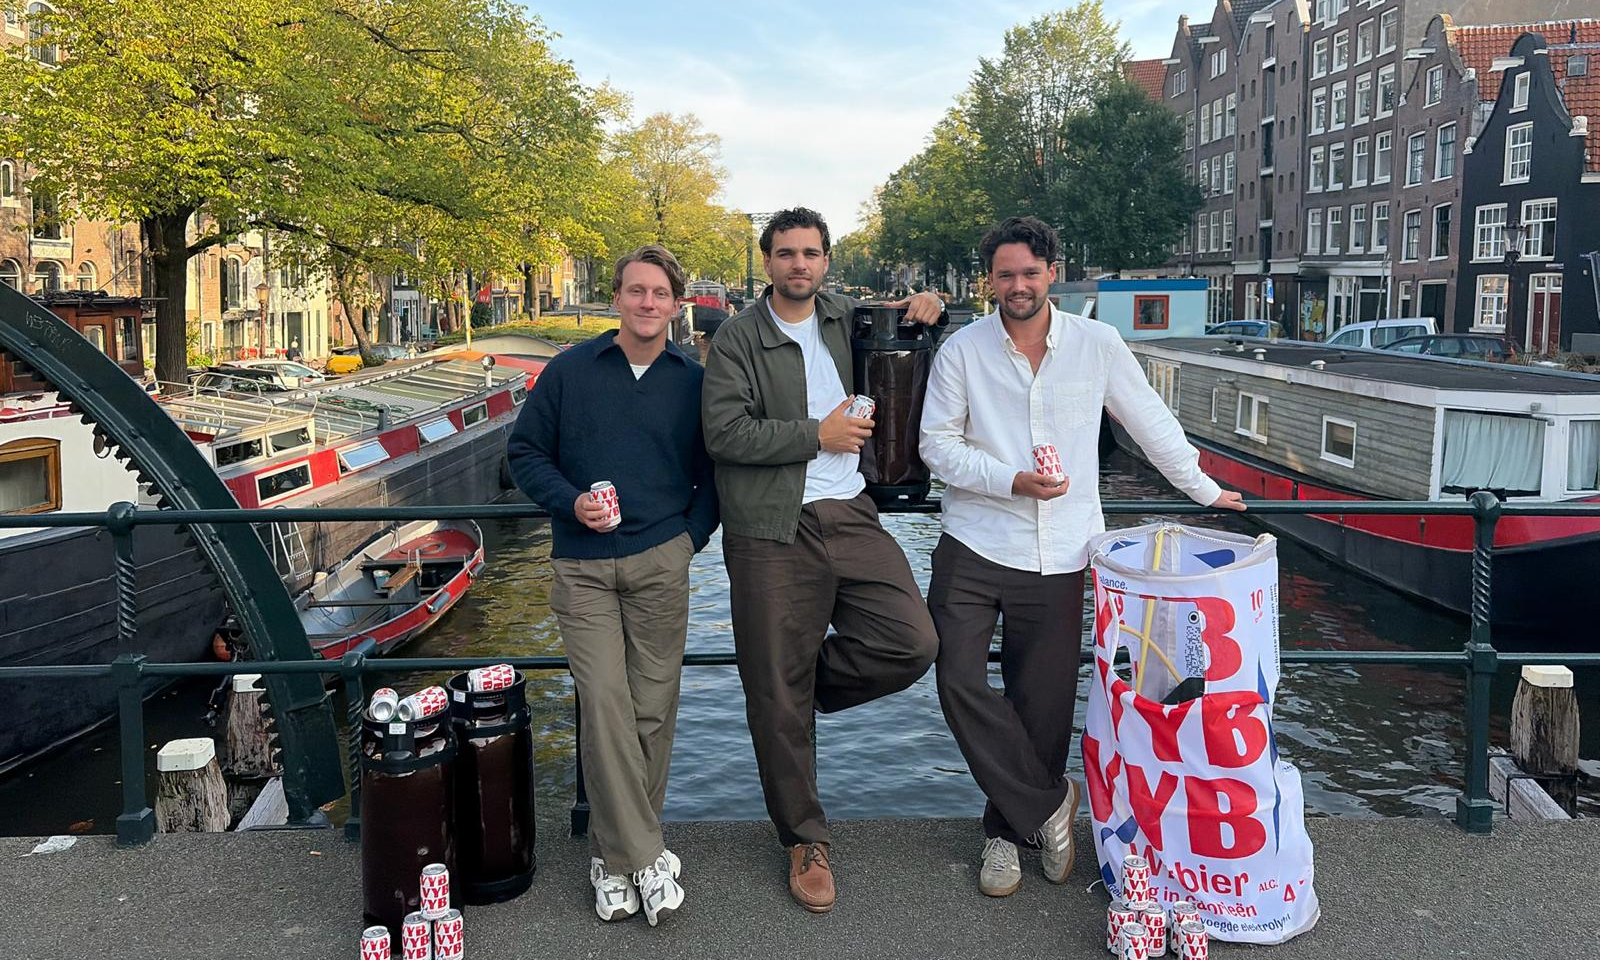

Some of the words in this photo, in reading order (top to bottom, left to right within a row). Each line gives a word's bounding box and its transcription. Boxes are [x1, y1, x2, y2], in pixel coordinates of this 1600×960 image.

[1083, 733, 1267, 860] VYB
[420, 874, 447, 887] VYB
[1129, 880, 1149, 890] VY
[422, 883, 449, 898] VYB
[1164, 886, 1180, 902] in
[421, 896, 447, 909] VYB
[435, 920, 462, 933] VYB
[361, 937, 389, 951] VYB
[403, 934, 429, 948] VYB
[437, 929, 464, 945] VYB
[1130, 936, 1149, 948] VY
[435, 942, 462, 956] VYB
[1189, 945, 1207, 956] VY
